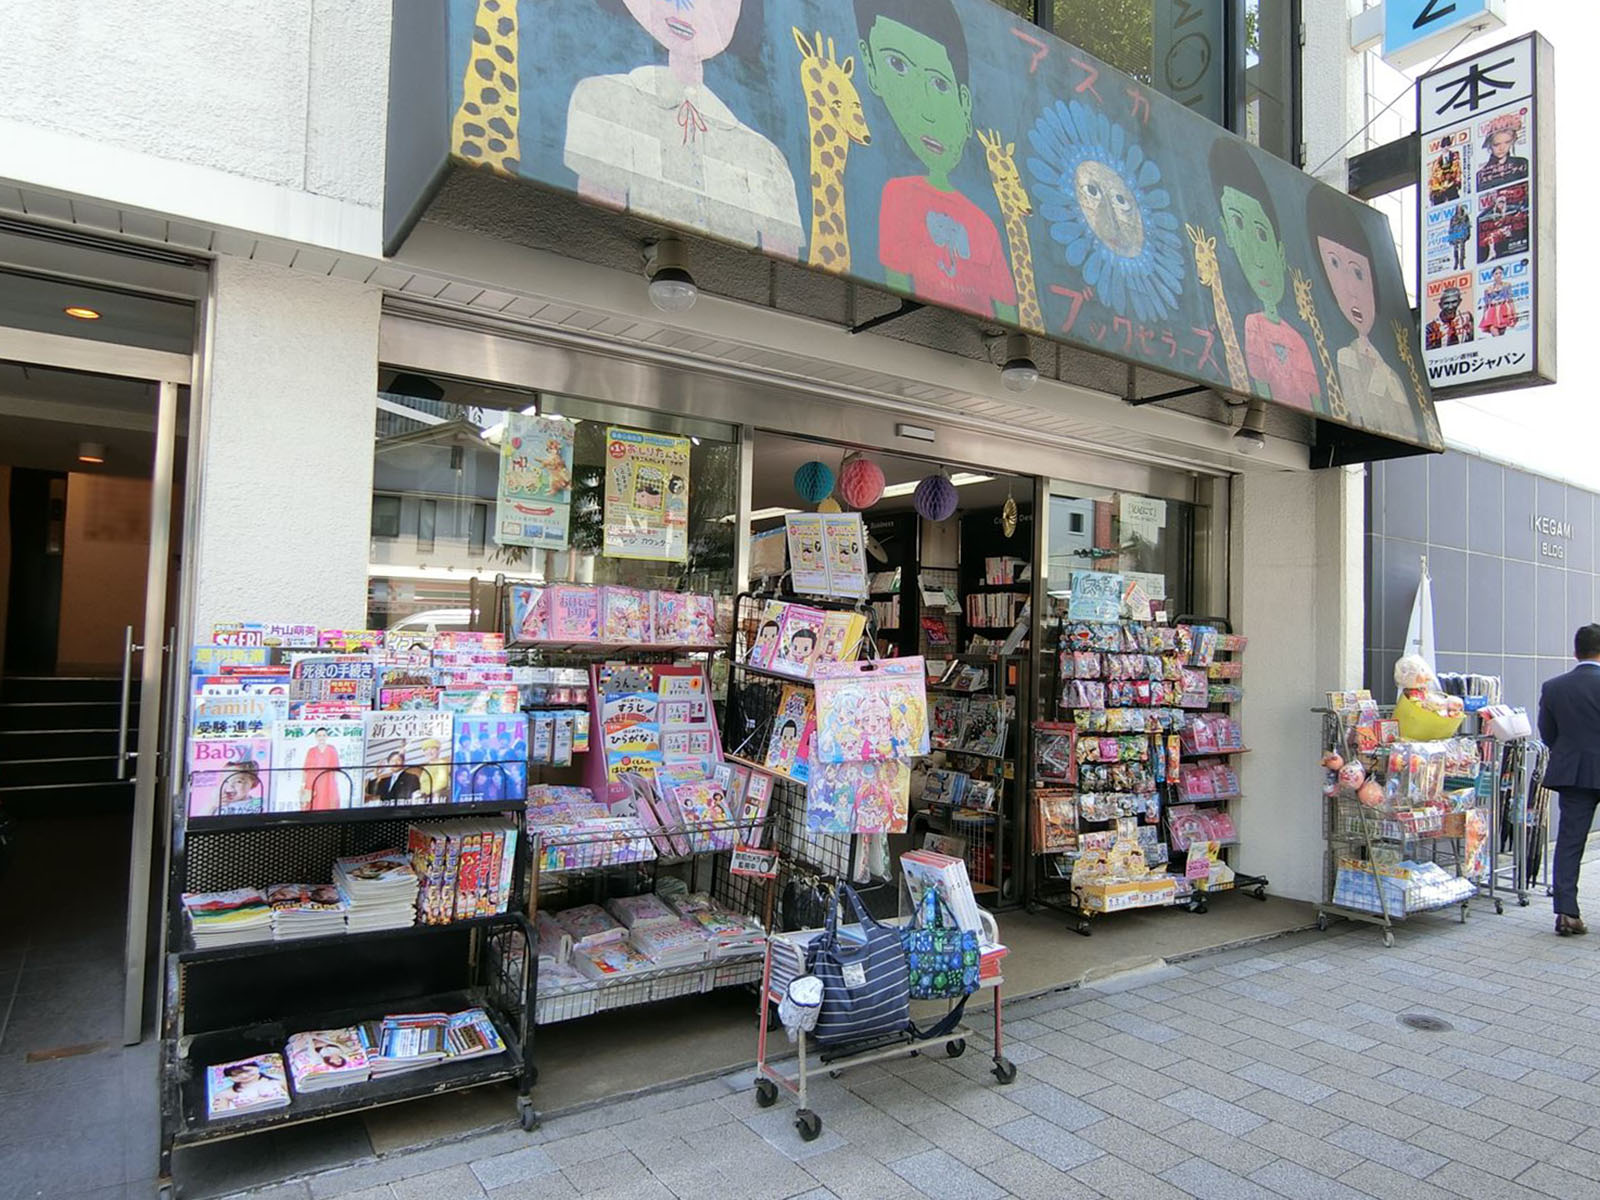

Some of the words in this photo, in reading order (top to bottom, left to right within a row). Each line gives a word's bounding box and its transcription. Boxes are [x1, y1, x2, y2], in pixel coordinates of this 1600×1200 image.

[1010, 27, 1150, 124] アスカ
[1436, 57, 1516, 115] 本
[1429, 277, 1469, 295] WWD
[1050, 285, 1225, 377] ブックセラーズ
[1429, 353, 1526, 380] WWDジャパン
[1530, 513, 1575, 540] IKEGAMI
[1542, 542, 1564, 559] BLDG
[270, 625, 317, 637] 片山萌美
[302, 663, 371, 679] 死後の手続き
[615, 678, 640, 689] うんこ
[618, 704, 645, 713] すうじ
[382, 714, 418, 722] ドキュメント
[461, 721, 524, 740] AERA
[610, 734, 648, 745] ひらがな
[195, 744, 248, 764] Baby
